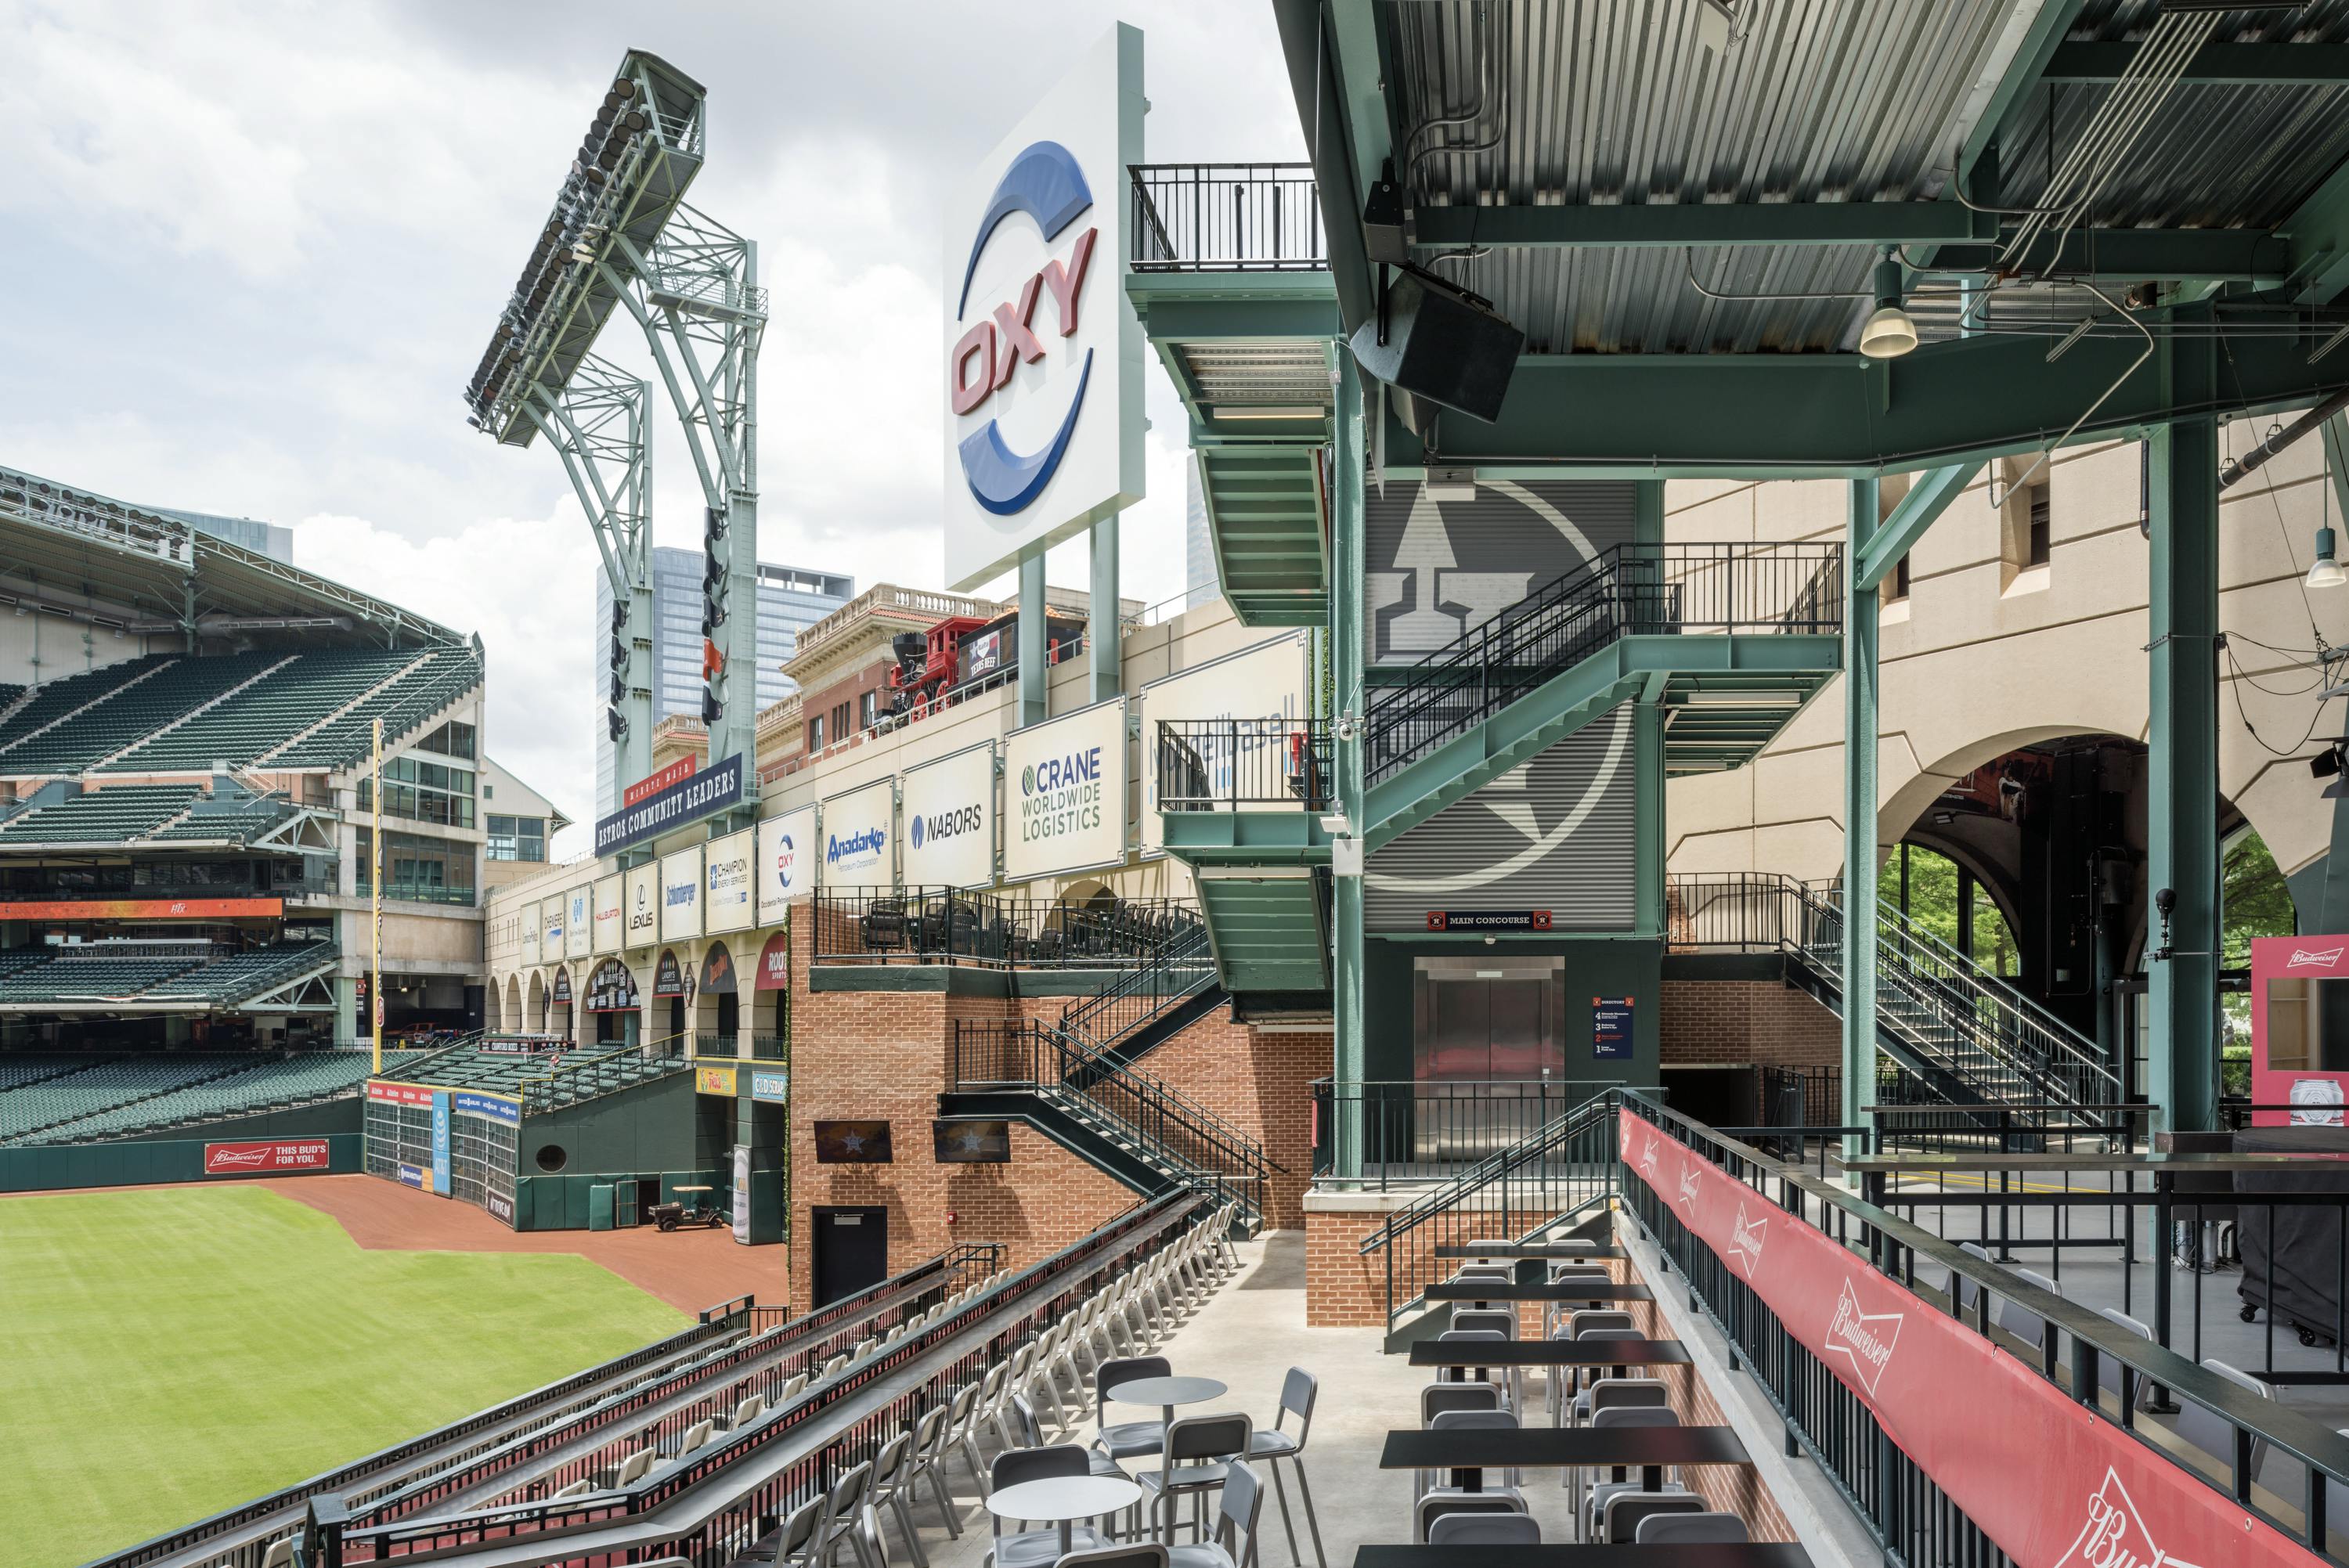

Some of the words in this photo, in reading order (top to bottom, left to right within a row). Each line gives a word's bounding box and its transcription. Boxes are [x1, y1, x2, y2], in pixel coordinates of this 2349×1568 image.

[951, 227, 1099, 416] OXY
[984, 656, 996, 669] BEEF
[1037, 746, 1100, 793] CRANE
[630, 778, 660, 801] MINUTE
[628, 792, 683, 834] COMMUNITY
[686, 769, 734, 809] LEADERS
[1022, 782, 1100, 818] WORLDWIDE
[927, 804, 982, 842] NABORS
[1023, 805, 1100, 842] LOGISTICS
[827, 827, 884, 866] Anadarko
[718, 858, 747, 878] CHAMPION
[778, 852, 794, 869] OXY
[838, 862, 857, 873] Petroleum
[857, 857, 879, 869] Corporation
[718, 878, 730, 889] ENERGY
[731, 874, 747, 885] SERVICES
[667, 882, 695, 907] Schlumberger
[596, 907, 620, 922] HALLIBURTON
[630, 911, 653, 929] LEXUS
[2292, 953, 2338, 964] Budweiser
[755, 1077, 767, 1094] C&D
[770, 1079, 783, 1095] SCRAP
[215, 1152, 265, 1162] Budweiser
[276, 1147, 297, 1155] THIS
[299, 1145, 326, 1154] BUD'S
[276, 1155, 294, 1165] FOR
[297, 1155, 317, 1164] YOU.
[1735, 1214, 1763, 1257] Budweiser
[1835, 1294, 1889, 1367] Budweiser
